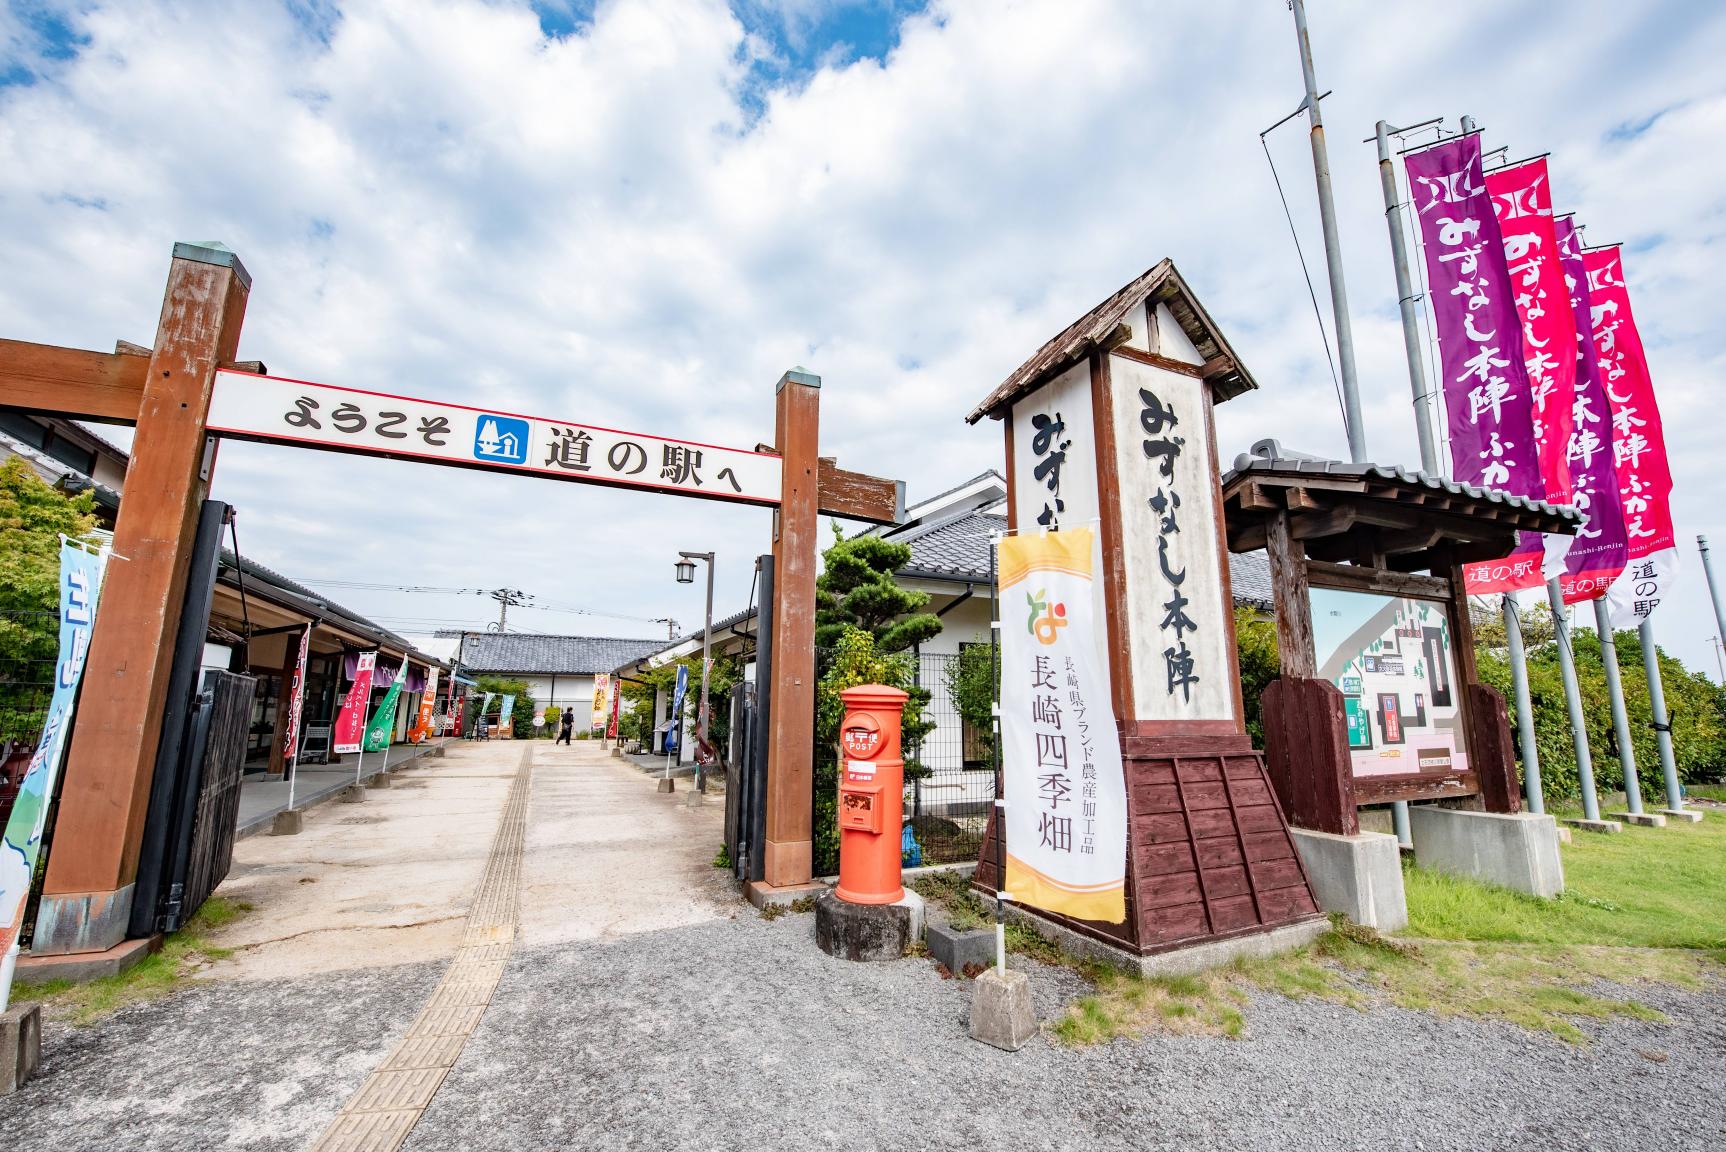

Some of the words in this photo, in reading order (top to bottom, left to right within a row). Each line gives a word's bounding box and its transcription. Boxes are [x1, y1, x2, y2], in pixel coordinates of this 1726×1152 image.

[1436, 217, 1517, 492] みずなし本陣ふか
[283, 396, 452, 446] ようこそ
[544, 426, 743, 494] 道の駅へ
[1139, 386, 1200, 705] みずなし本陣
[1469, 560, 1534, 583] 道の駅
[1632, 561, 1661, 619] 道の駅
[849, 742, 873, 751] POST
[1030, 655, 1073, 854] 長崎四季畑
[1064, 656, 1097, 855] 長崎県ブランド農産加工品
